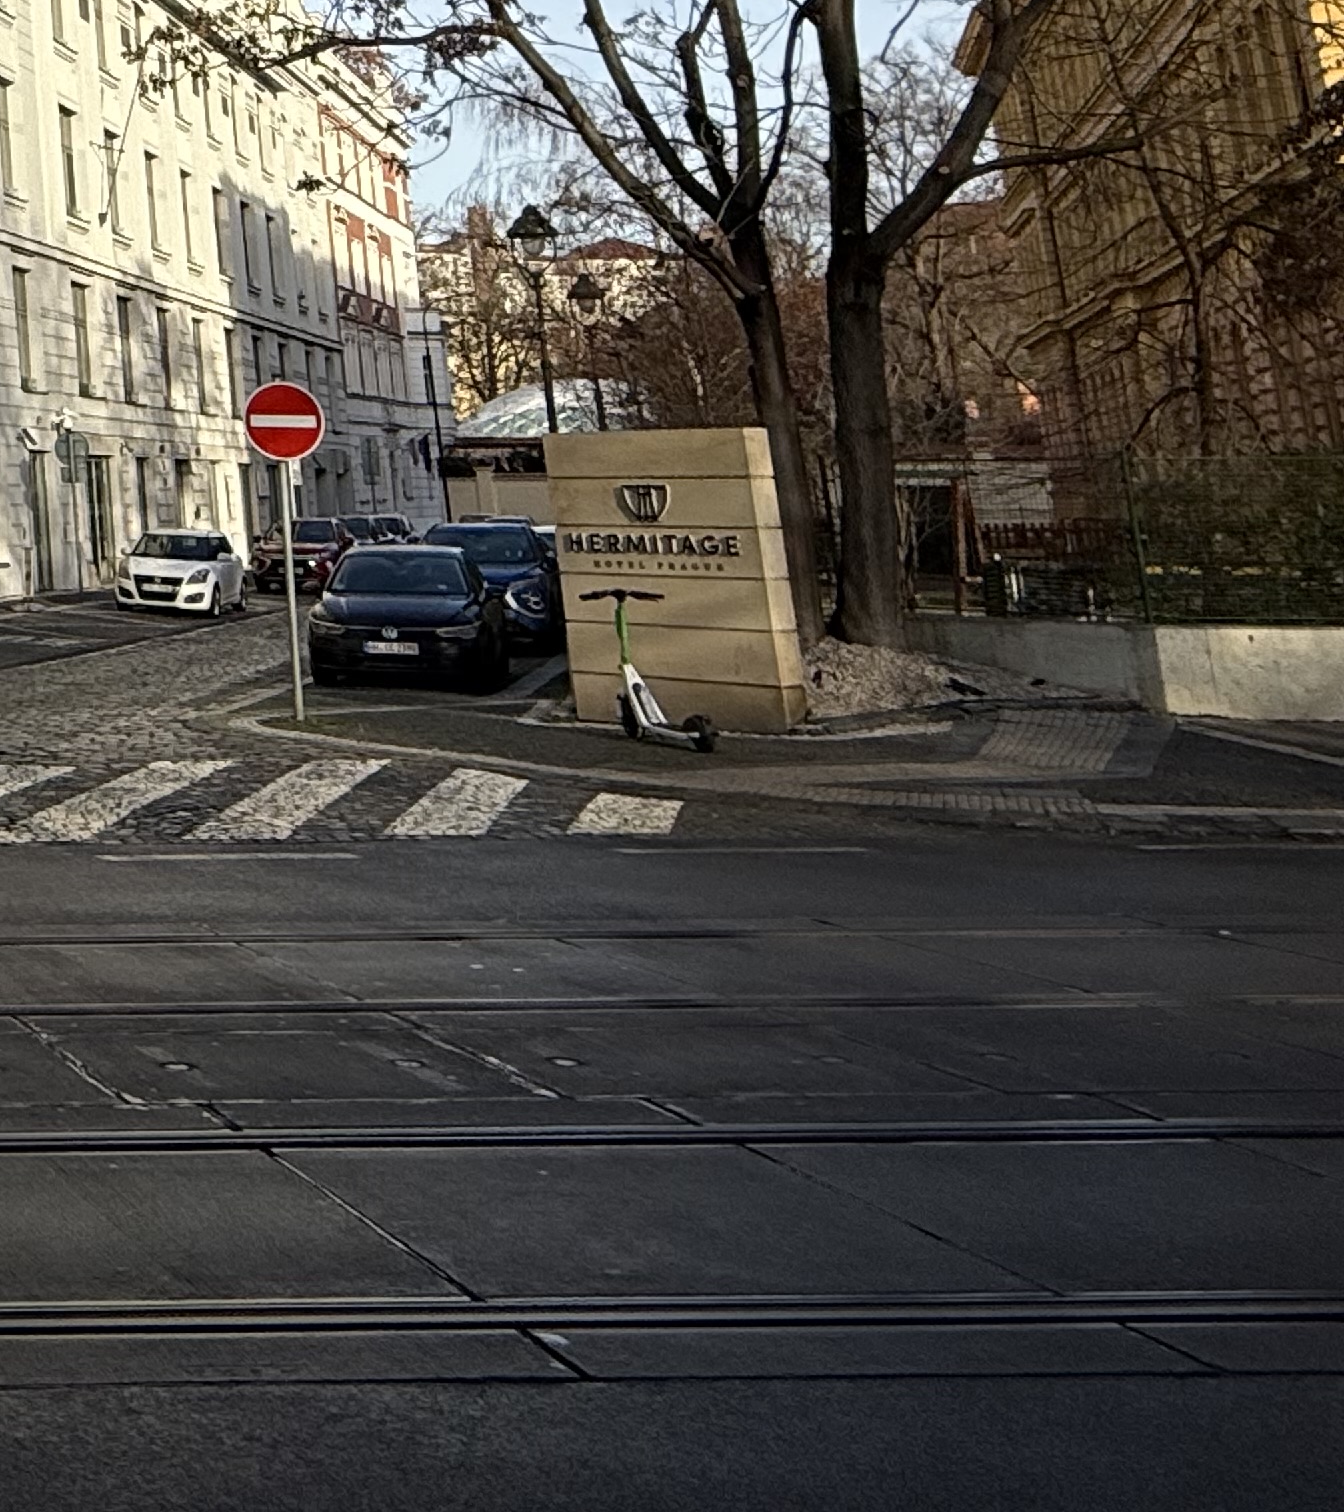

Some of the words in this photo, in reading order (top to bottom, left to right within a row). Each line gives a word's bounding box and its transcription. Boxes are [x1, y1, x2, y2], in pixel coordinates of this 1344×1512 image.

[567, 533, 741, 557] HERMITAGE
[593, 560, 646, 569] HOTEL
[657, 561, 725, 572] PRAGUE
